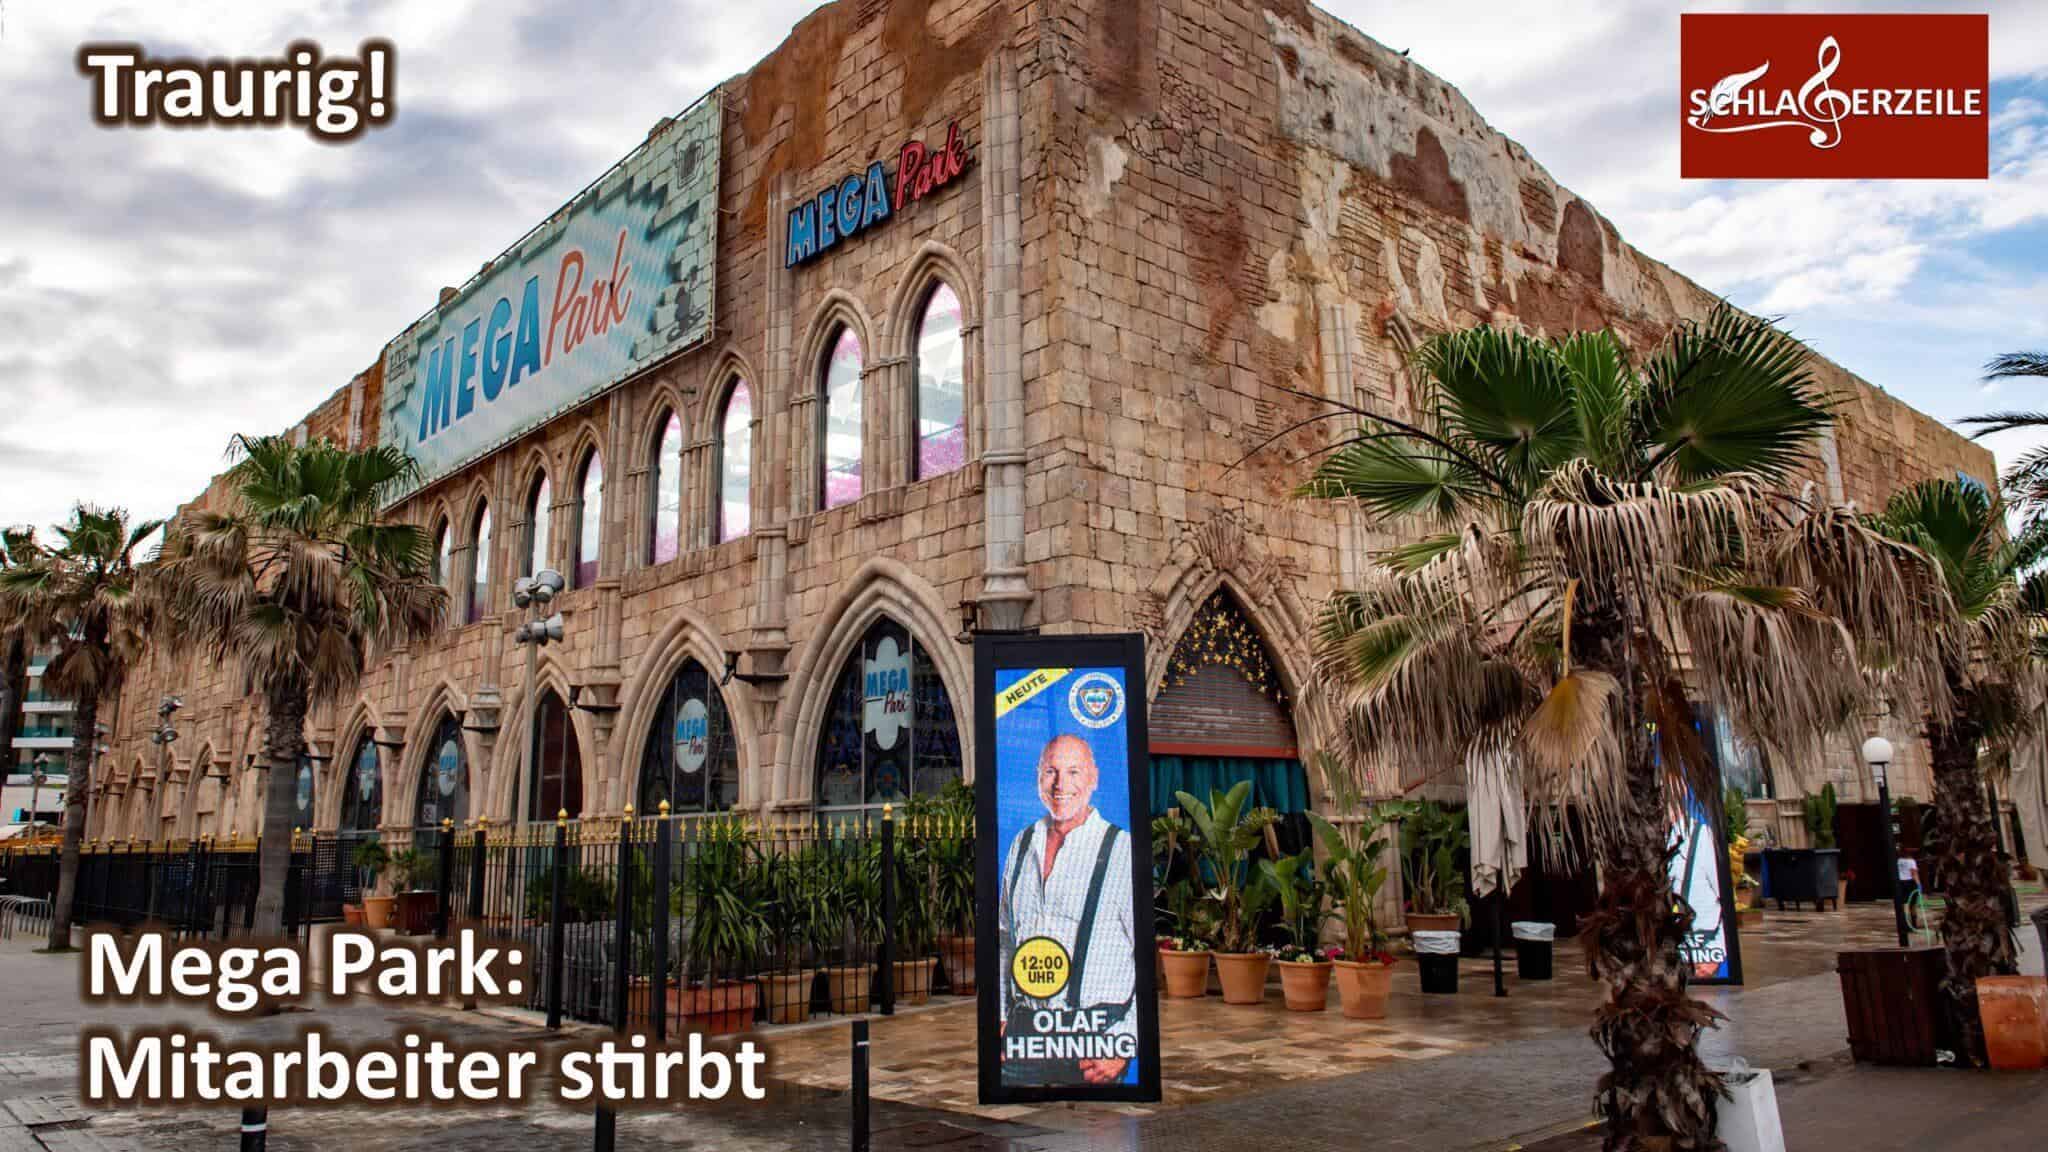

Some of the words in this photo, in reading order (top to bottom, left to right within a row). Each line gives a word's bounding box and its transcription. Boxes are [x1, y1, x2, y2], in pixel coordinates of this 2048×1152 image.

[785, 160, 891, 269] MEGA
[895, 119, 969, 211] Park
[417, 274, 541, 443] MEGA
[543, 228, 633, 366] Park
[865, 667, 909, 697] MEGA
[1006, 672, 1048, 705] HEUTE
[1020, 955, 1064, 971] 12:00
[1679, 947, 1724, 963] NING
[1027, 971, 1055, 984] UHR
[1033, 1009, 1108, 1034] OLAF
[1006, 1035, 1136, 1059] HENNING
